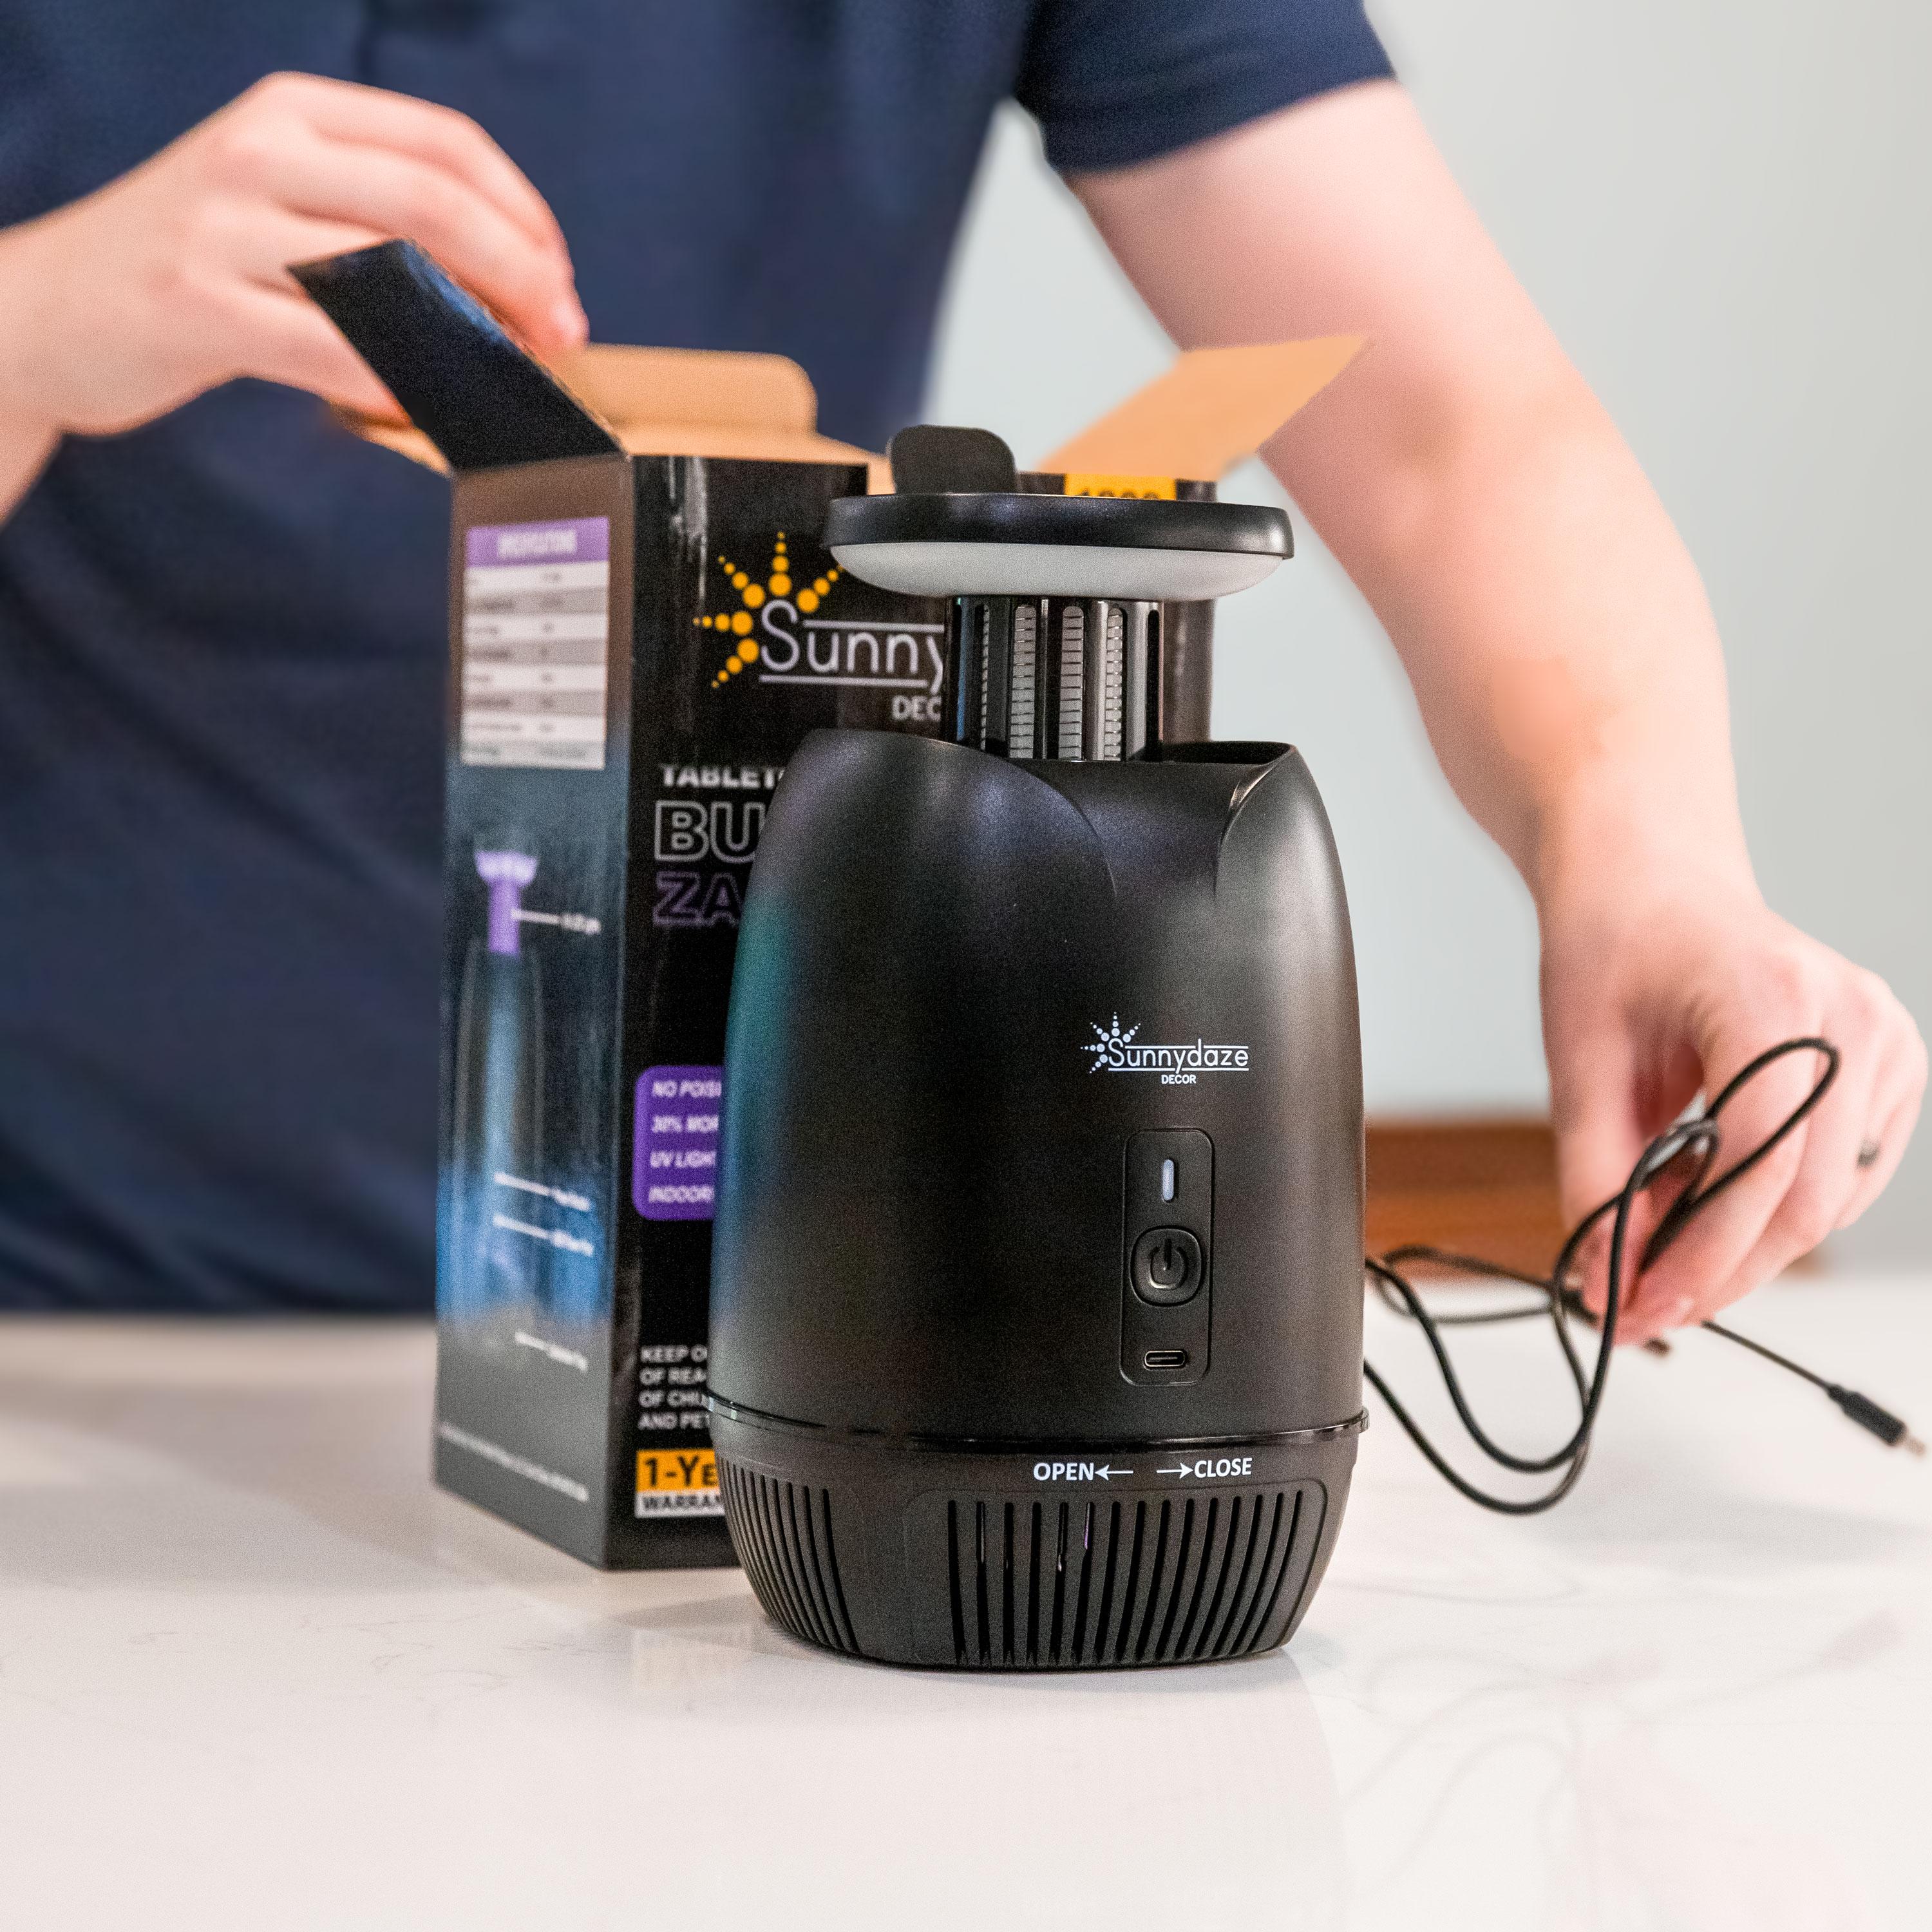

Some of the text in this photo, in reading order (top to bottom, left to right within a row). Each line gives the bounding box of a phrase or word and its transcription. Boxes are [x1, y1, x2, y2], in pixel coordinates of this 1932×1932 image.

[761, 600, 943, 693] Sunny
[891, 695, 942, 721] DEC
[660, 764, 784, 790] TABLET
[1108, 1038, 1249, 1074] Sunnydaze
[1161, 1074, 1196, 1084] DECOR
[652, 1081, 676, 1097] NO
[641, 1345, 688, 1363] KEEP
[639, 1367, 665, 1385] OF
[639, 1390, 664, 1408] OF
[638, 1412, 677, 1430] AND
[1033, 1457, 1252, 1481] OPEN CLOSE
